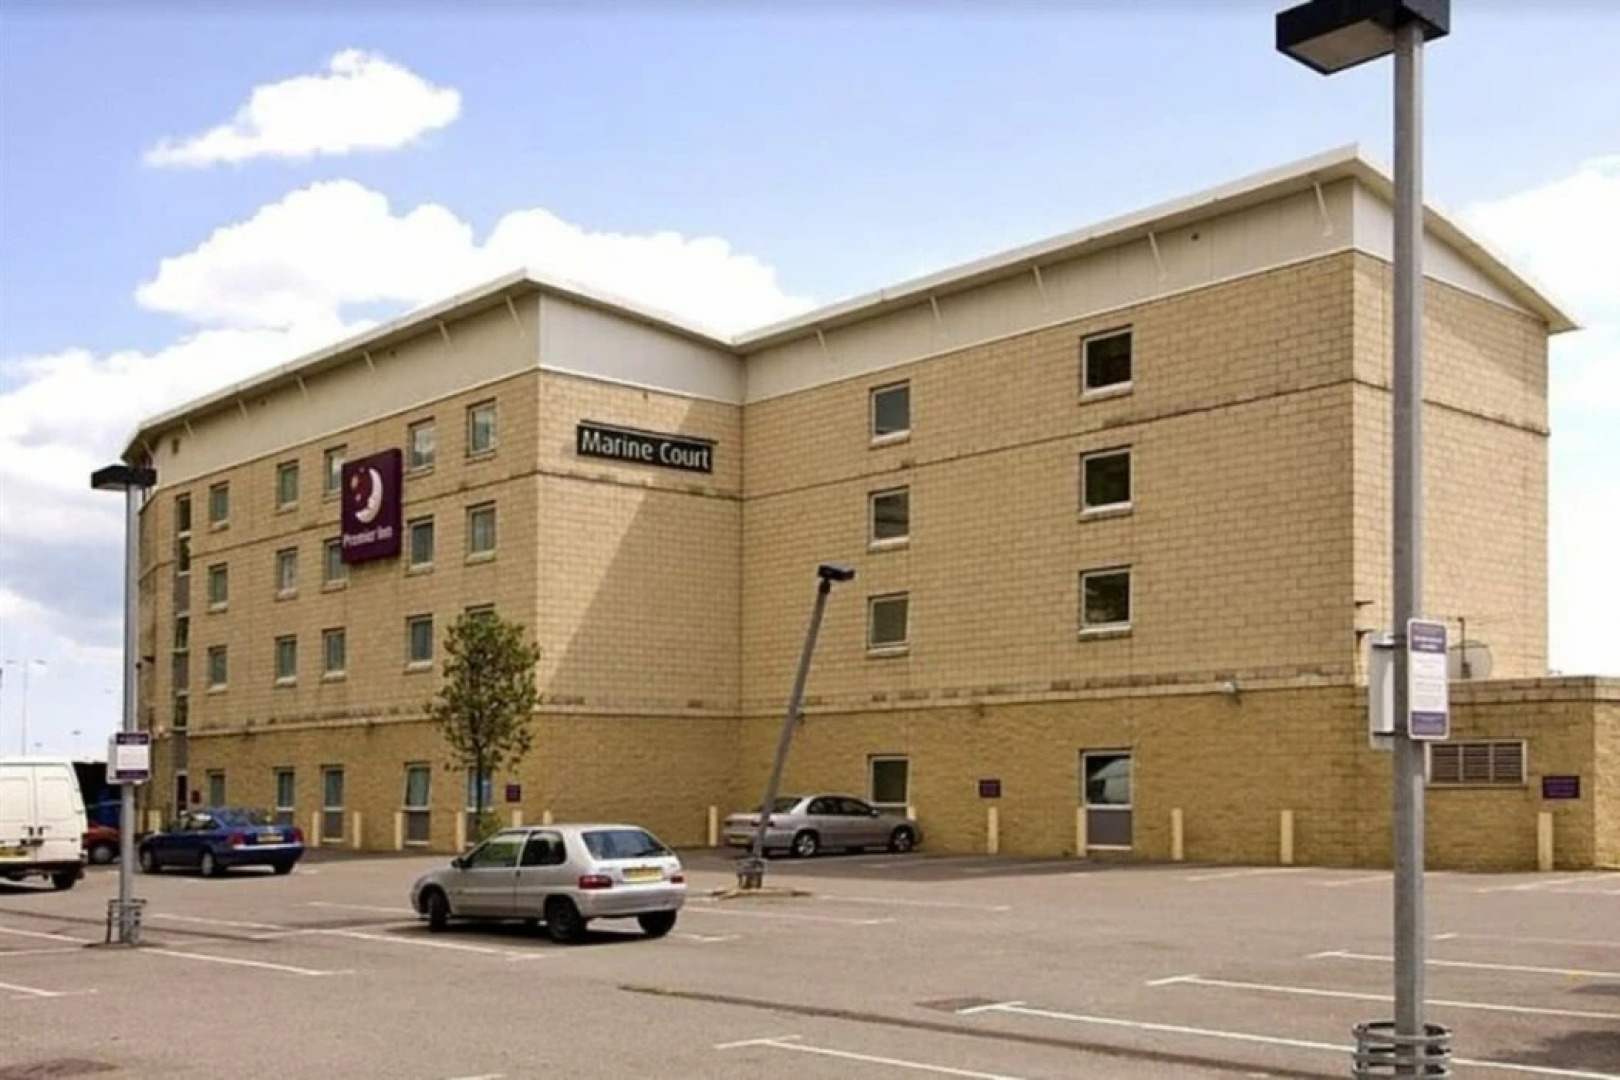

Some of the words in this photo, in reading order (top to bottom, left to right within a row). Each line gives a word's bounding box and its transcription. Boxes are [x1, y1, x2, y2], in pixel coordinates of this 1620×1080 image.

[582, 429, 654, 461] Marine
[660, 441, 709, 470] Court
[343, 530, 376, 548] Premier
[377, 525, 393, 540] Inn
